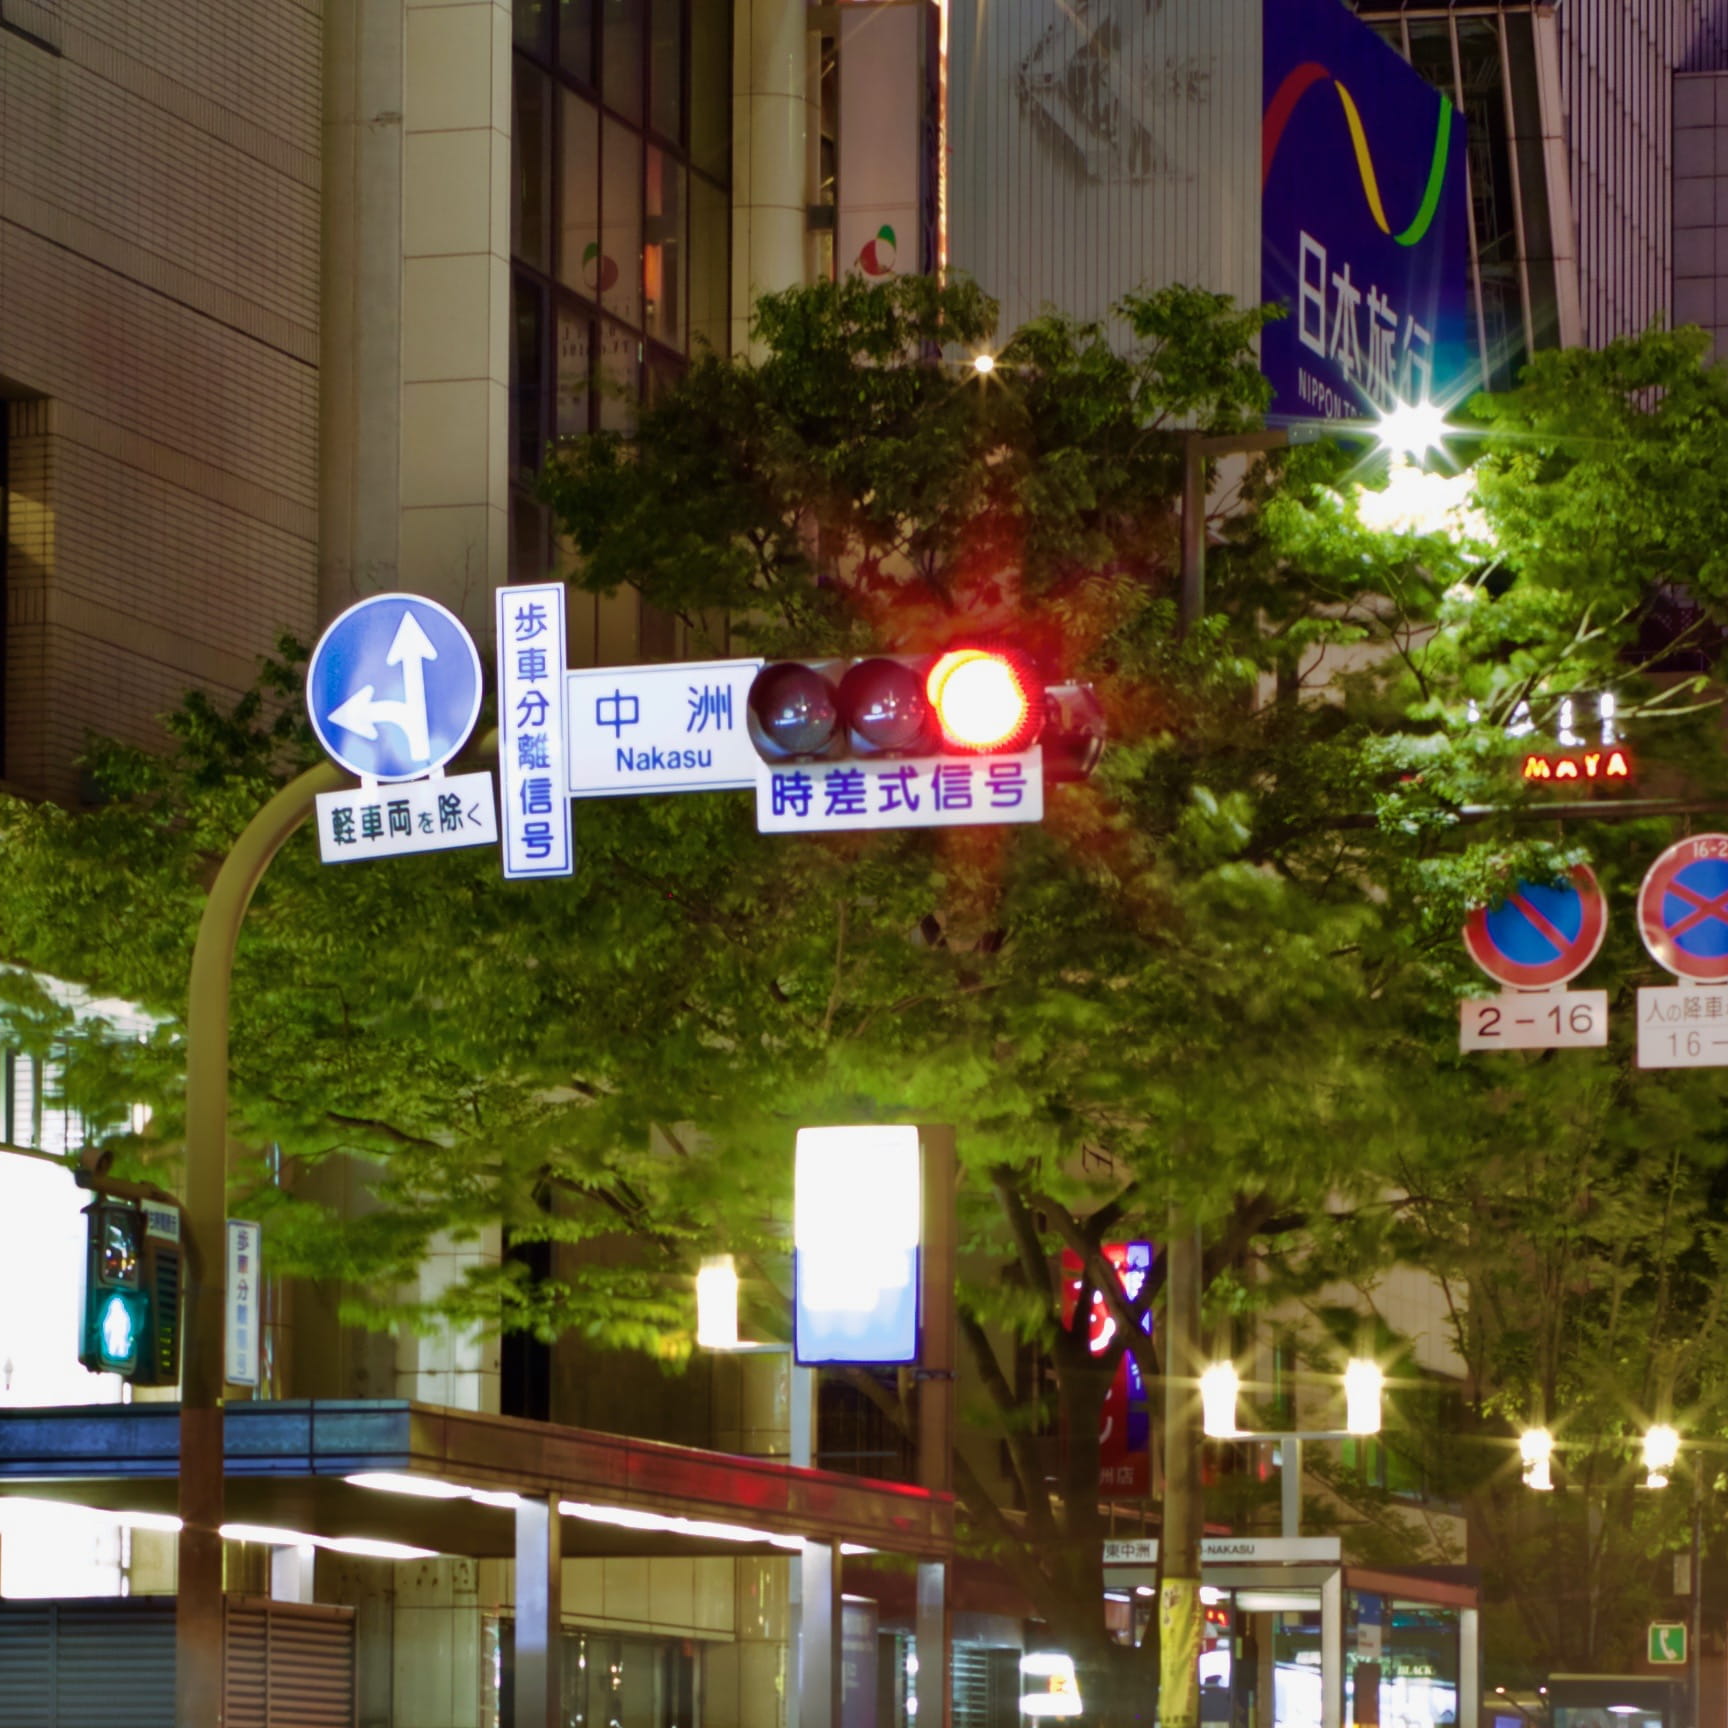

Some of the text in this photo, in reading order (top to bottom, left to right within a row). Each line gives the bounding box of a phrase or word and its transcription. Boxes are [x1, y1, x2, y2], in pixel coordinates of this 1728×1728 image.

[1299, 229, 1431, 405] 日本旅行
[514, 602, 554, 859] 歩車分離信号
[595, 684, 733, 739] 中洲
[616, 746, 712, 772] Nakasu
[772, 762, 1027, 817] 時差式信号
[331, 792, 482, 846] 軽車両を除く
